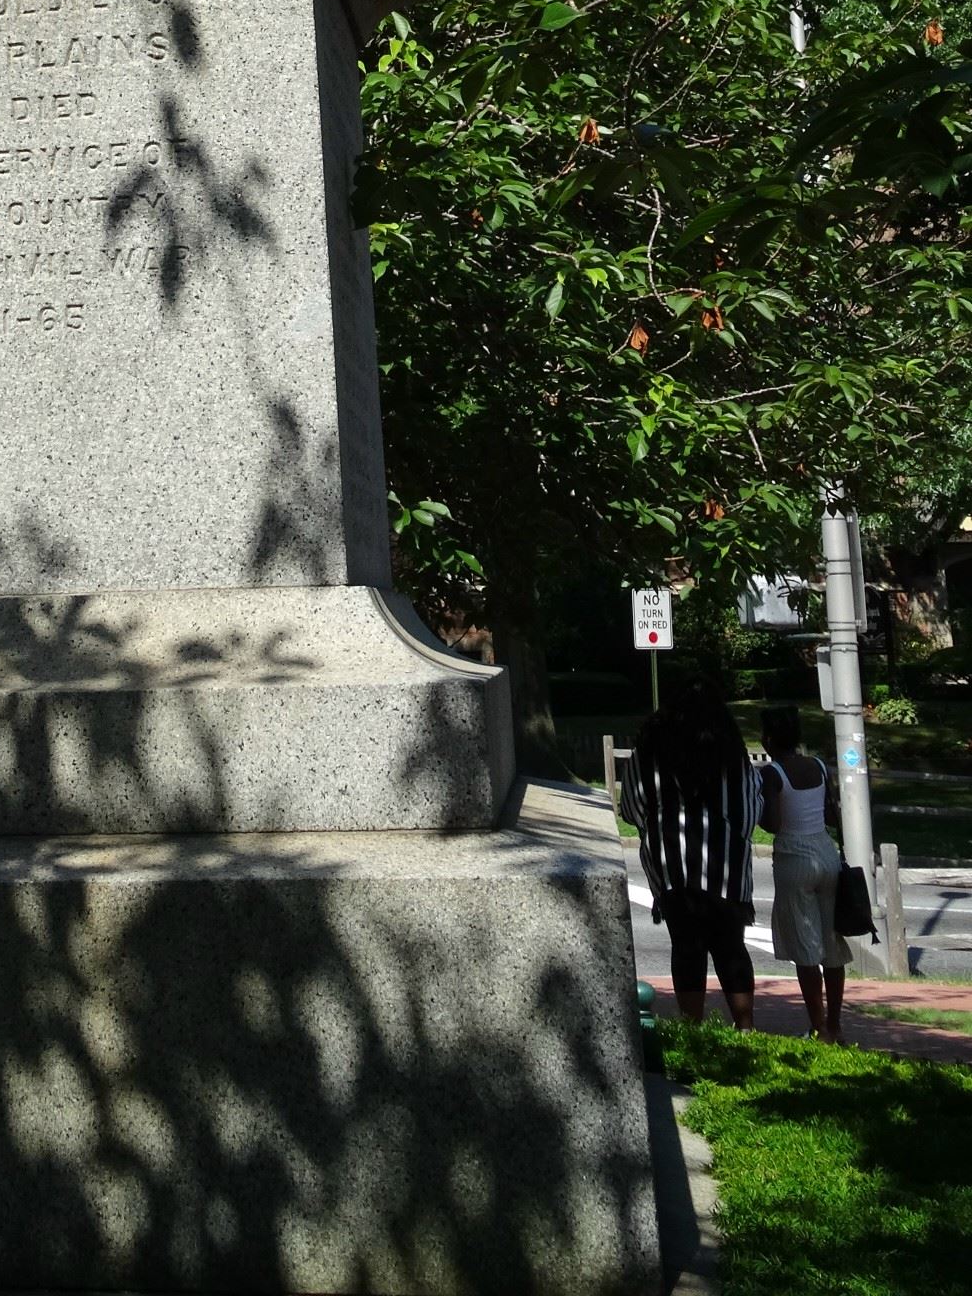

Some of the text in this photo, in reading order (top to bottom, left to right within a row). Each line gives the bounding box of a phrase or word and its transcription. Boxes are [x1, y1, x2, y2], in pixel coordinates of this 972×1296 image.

[7, 31, 170, 69] PLAINS
[11, 91, 98, 122] DIED
[100, 245, 190, 273] WAR
[643, 594, 660, 605] NO
[641, 609, 663, 618] TURN
[638, 620, 668, 629] ON RED
